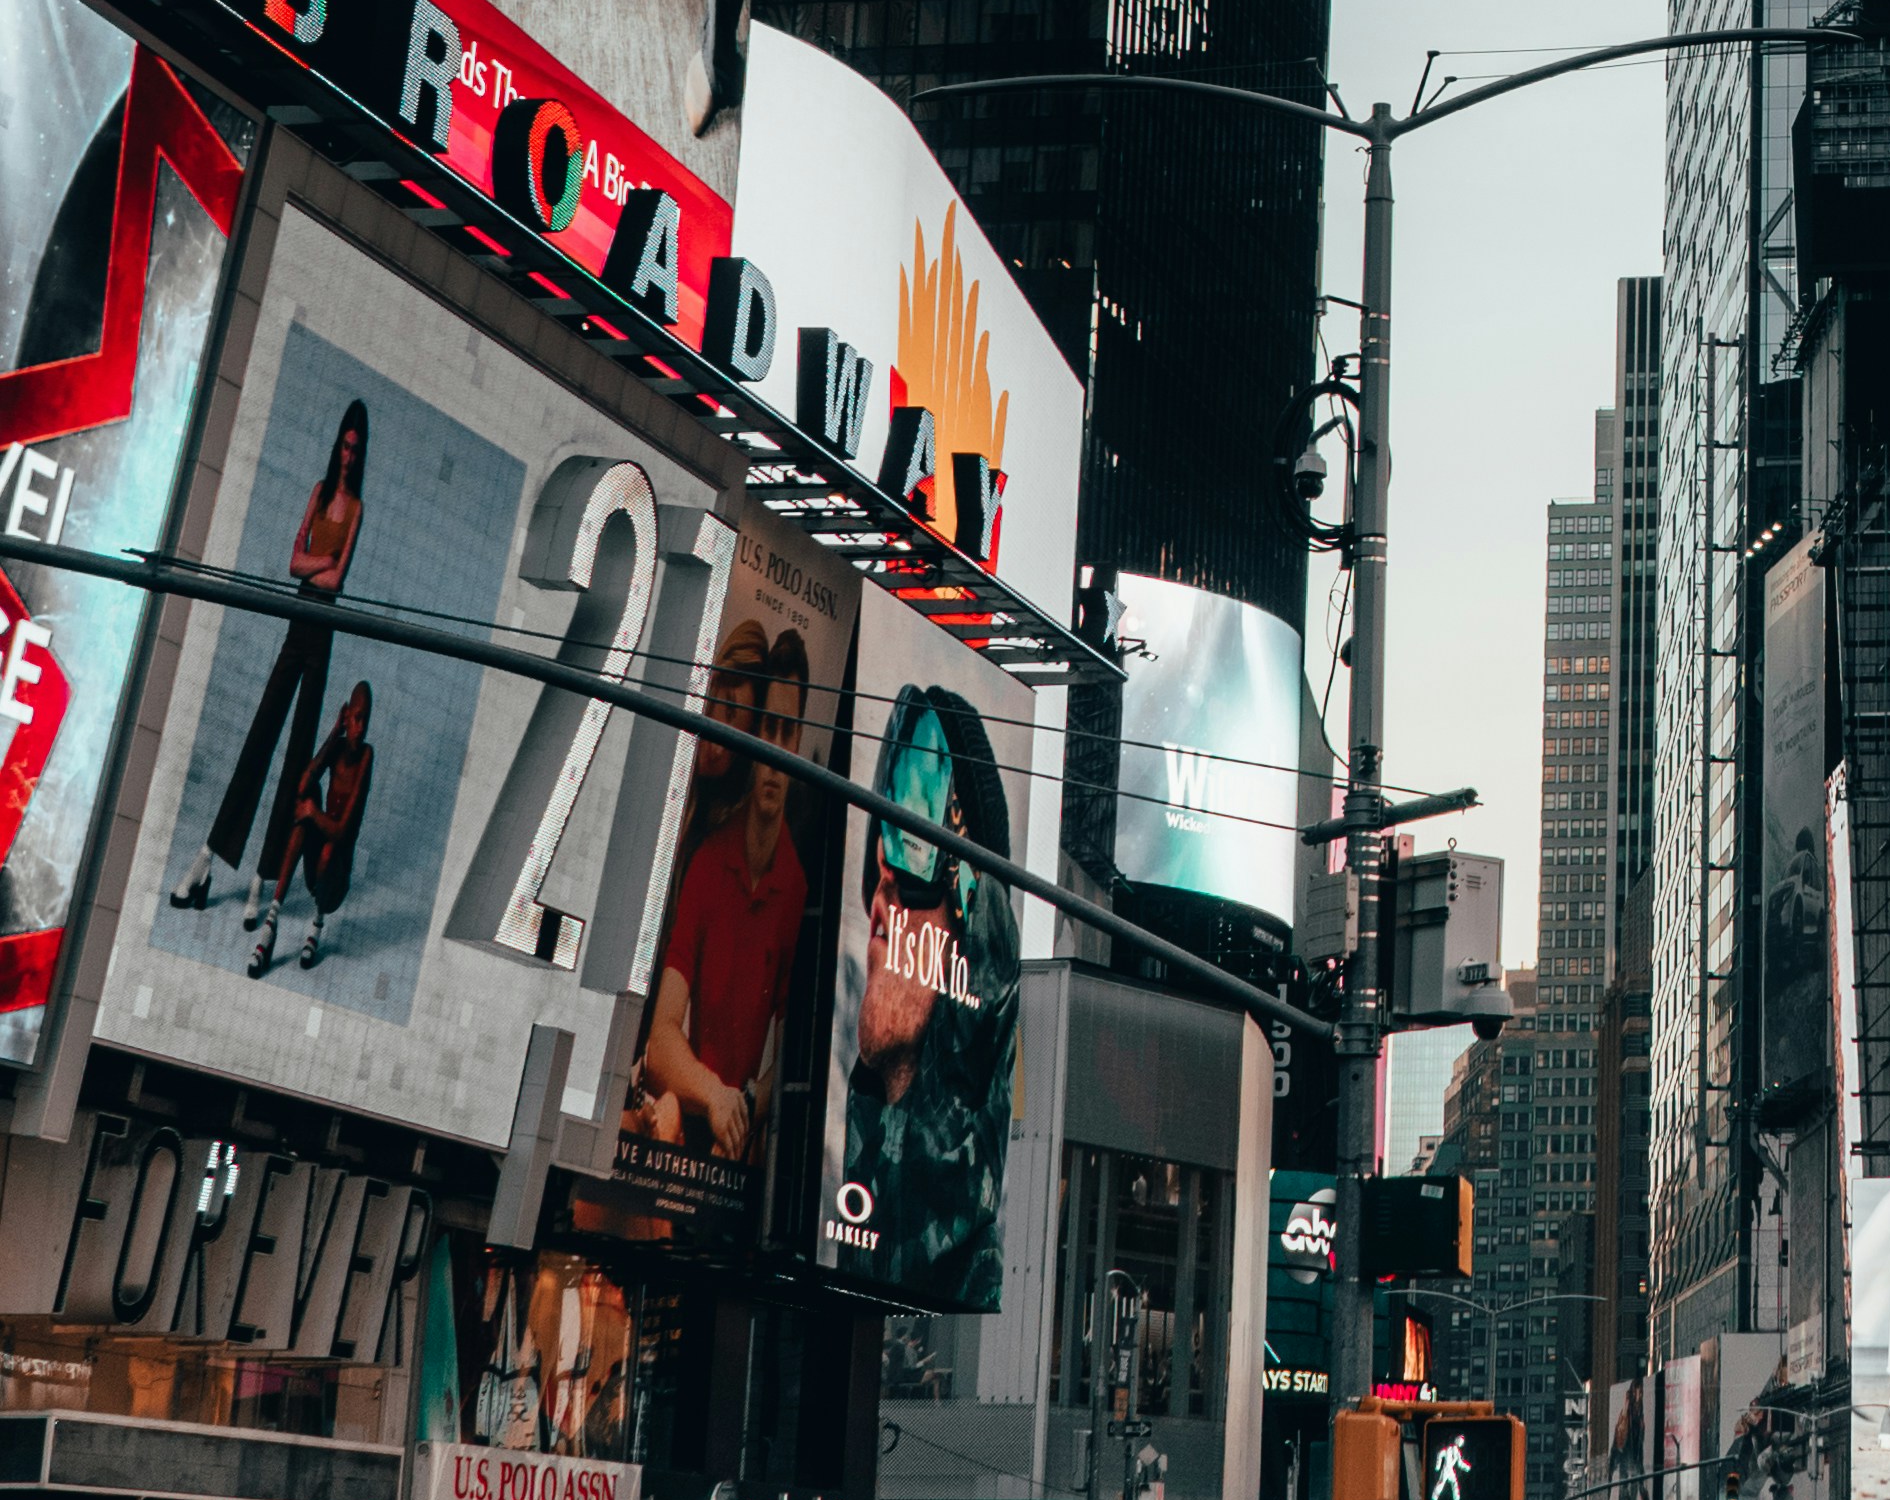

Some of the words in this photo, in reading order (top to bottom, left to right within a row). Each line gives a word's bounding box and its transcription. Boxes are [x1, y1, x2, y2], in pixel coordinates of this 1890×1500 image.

[740, 535, 763, 574] U.S.
[765, 552, 803, 596] POLO
[802, 577, 838, 621] ASSN.
[884, 904, 916, 979] It's
[918, 921, 950, 995] OK
[646, 1150, 747, 1191] AUTHENTICALLY
[53, 1111, 433, 1367] FOREVER
[825, 1219, 880, 1250] OAKLEY
